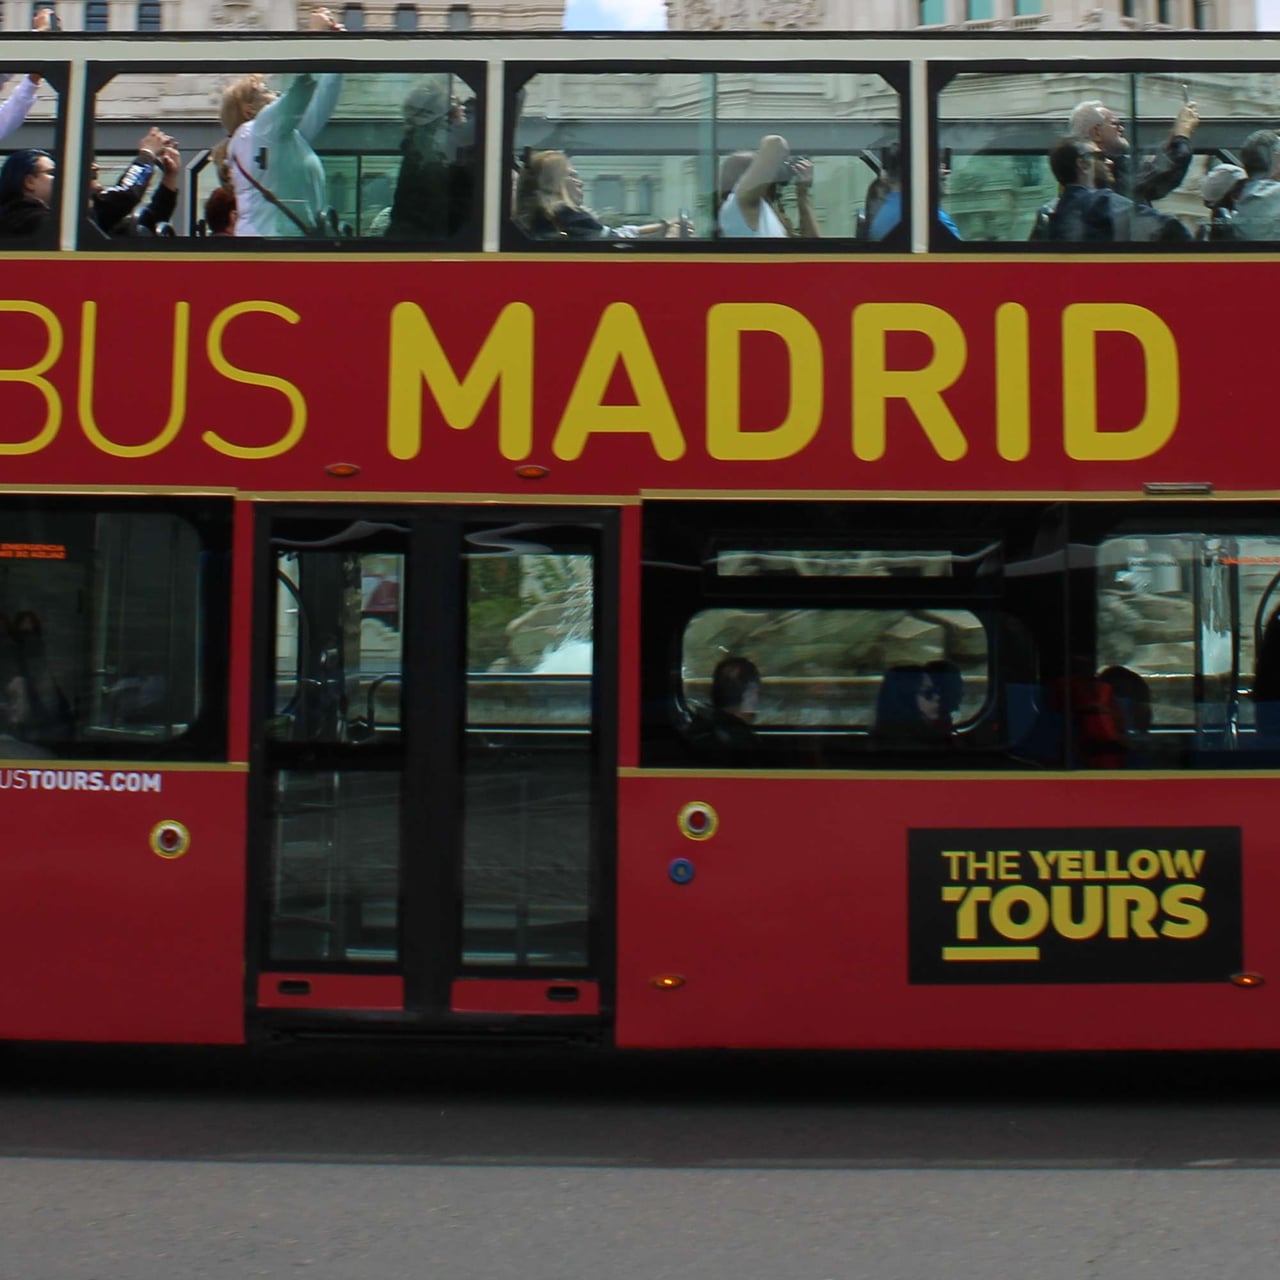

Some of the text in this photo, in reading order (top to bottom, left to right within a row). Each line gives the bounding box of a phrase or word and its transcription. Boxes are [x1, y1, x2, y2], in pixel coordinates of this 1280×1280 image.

[388, 300, 1180, 463] MADRID
[942, 850, 1205, 880] THE YELLOW
[942, 885, 1209, 940] TOURS
